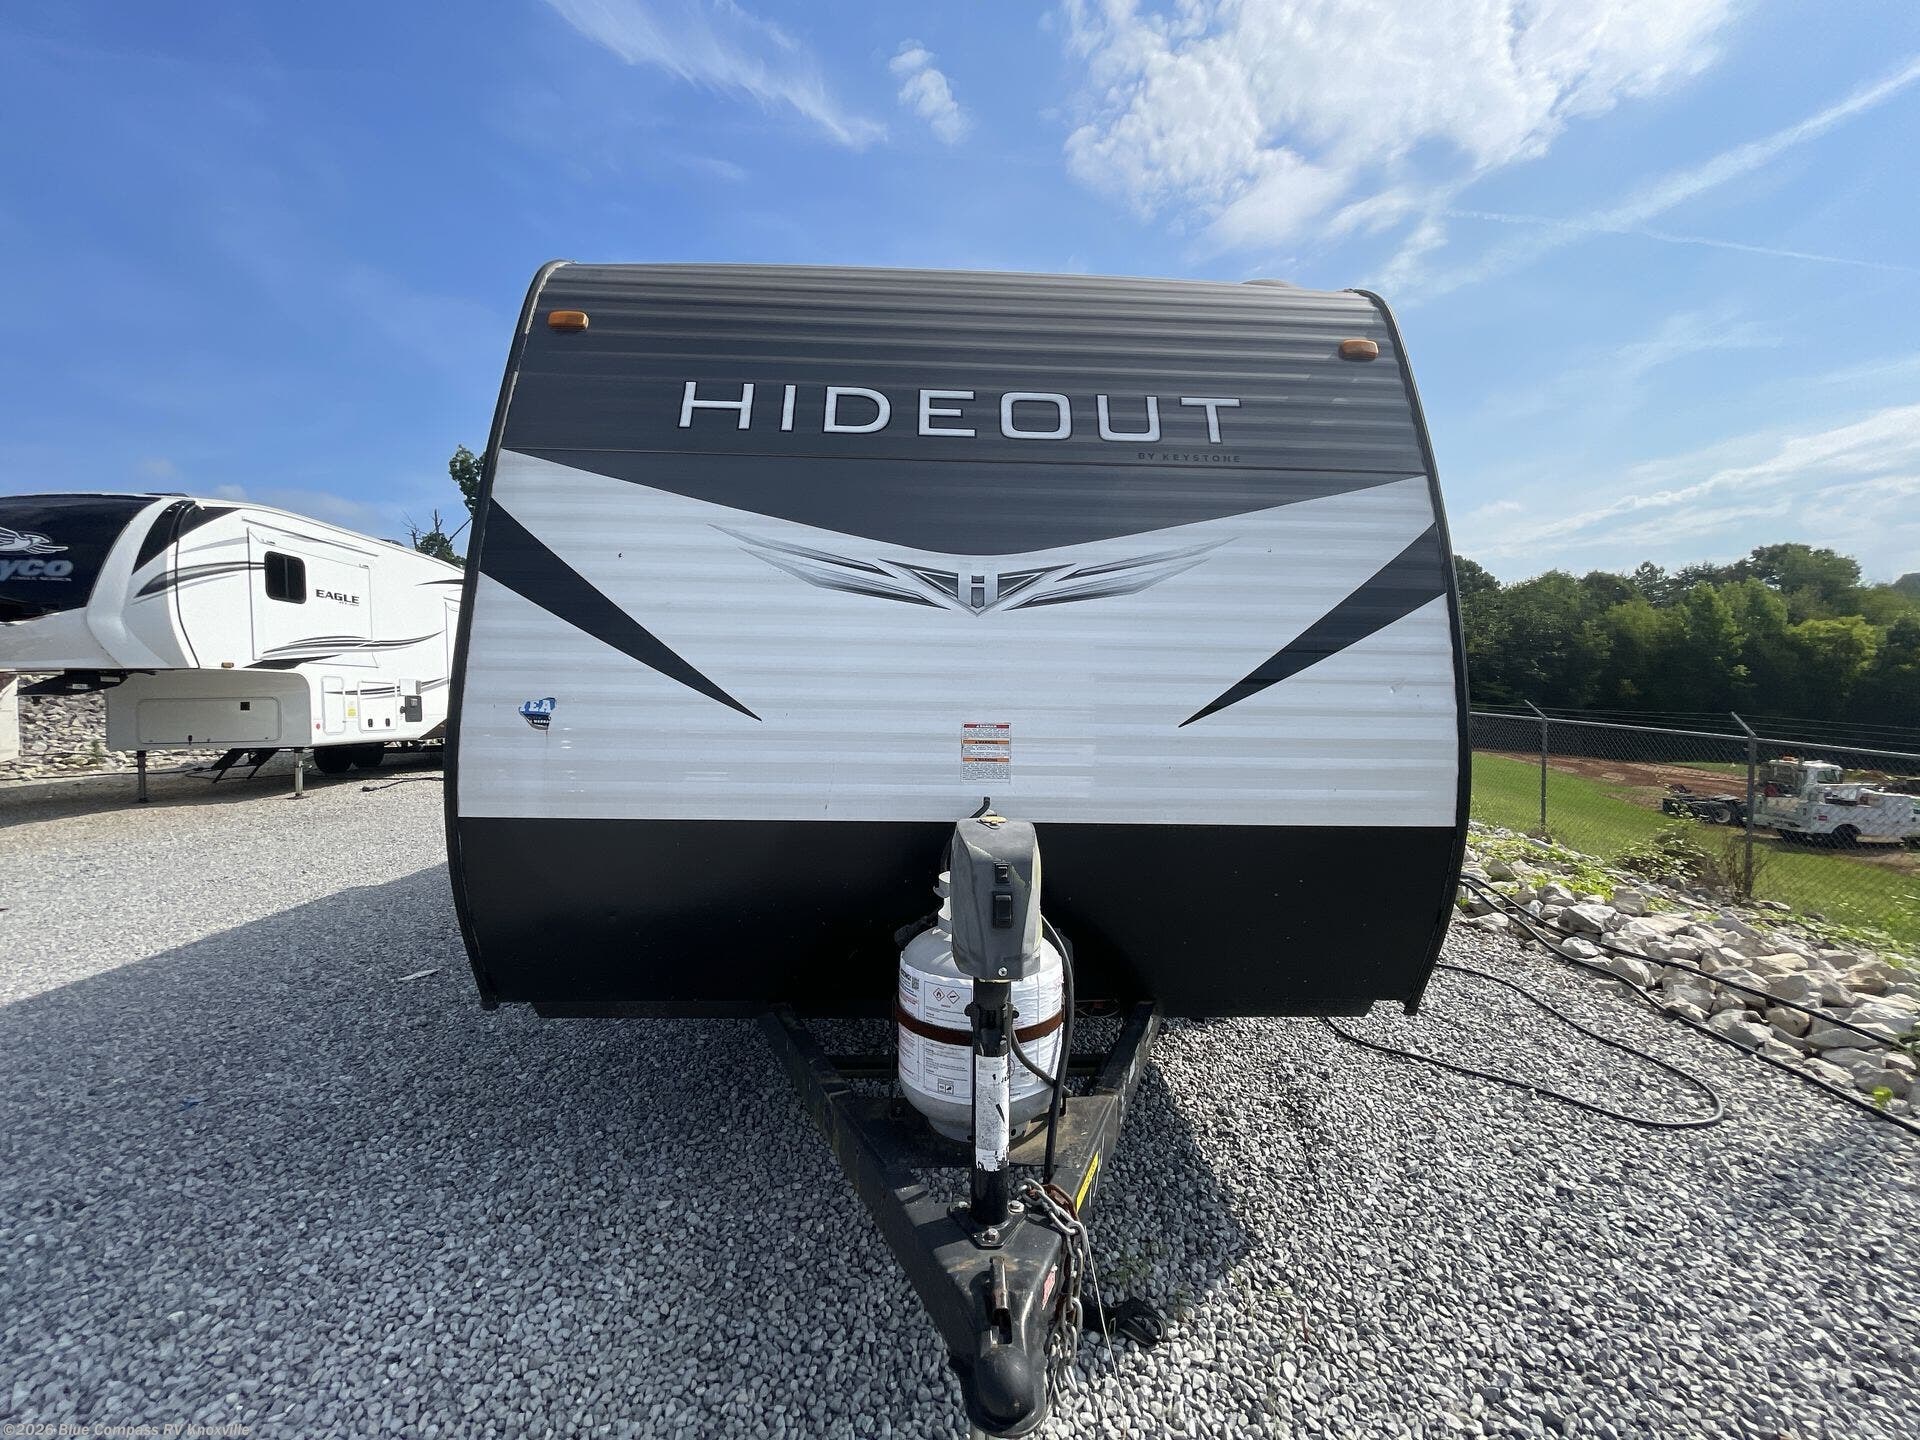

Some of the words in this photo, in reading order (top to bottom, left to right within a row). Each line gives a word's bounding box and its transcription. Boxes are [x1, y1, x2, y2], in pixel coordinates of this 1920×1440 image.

[678, 381, 1241, 444] HIDEOUT
[1138, 452, 1155, 460] BY
[1162, 453, 1241, 463] KEYSTONE
[315, 589, 360, 605] EAGLE
